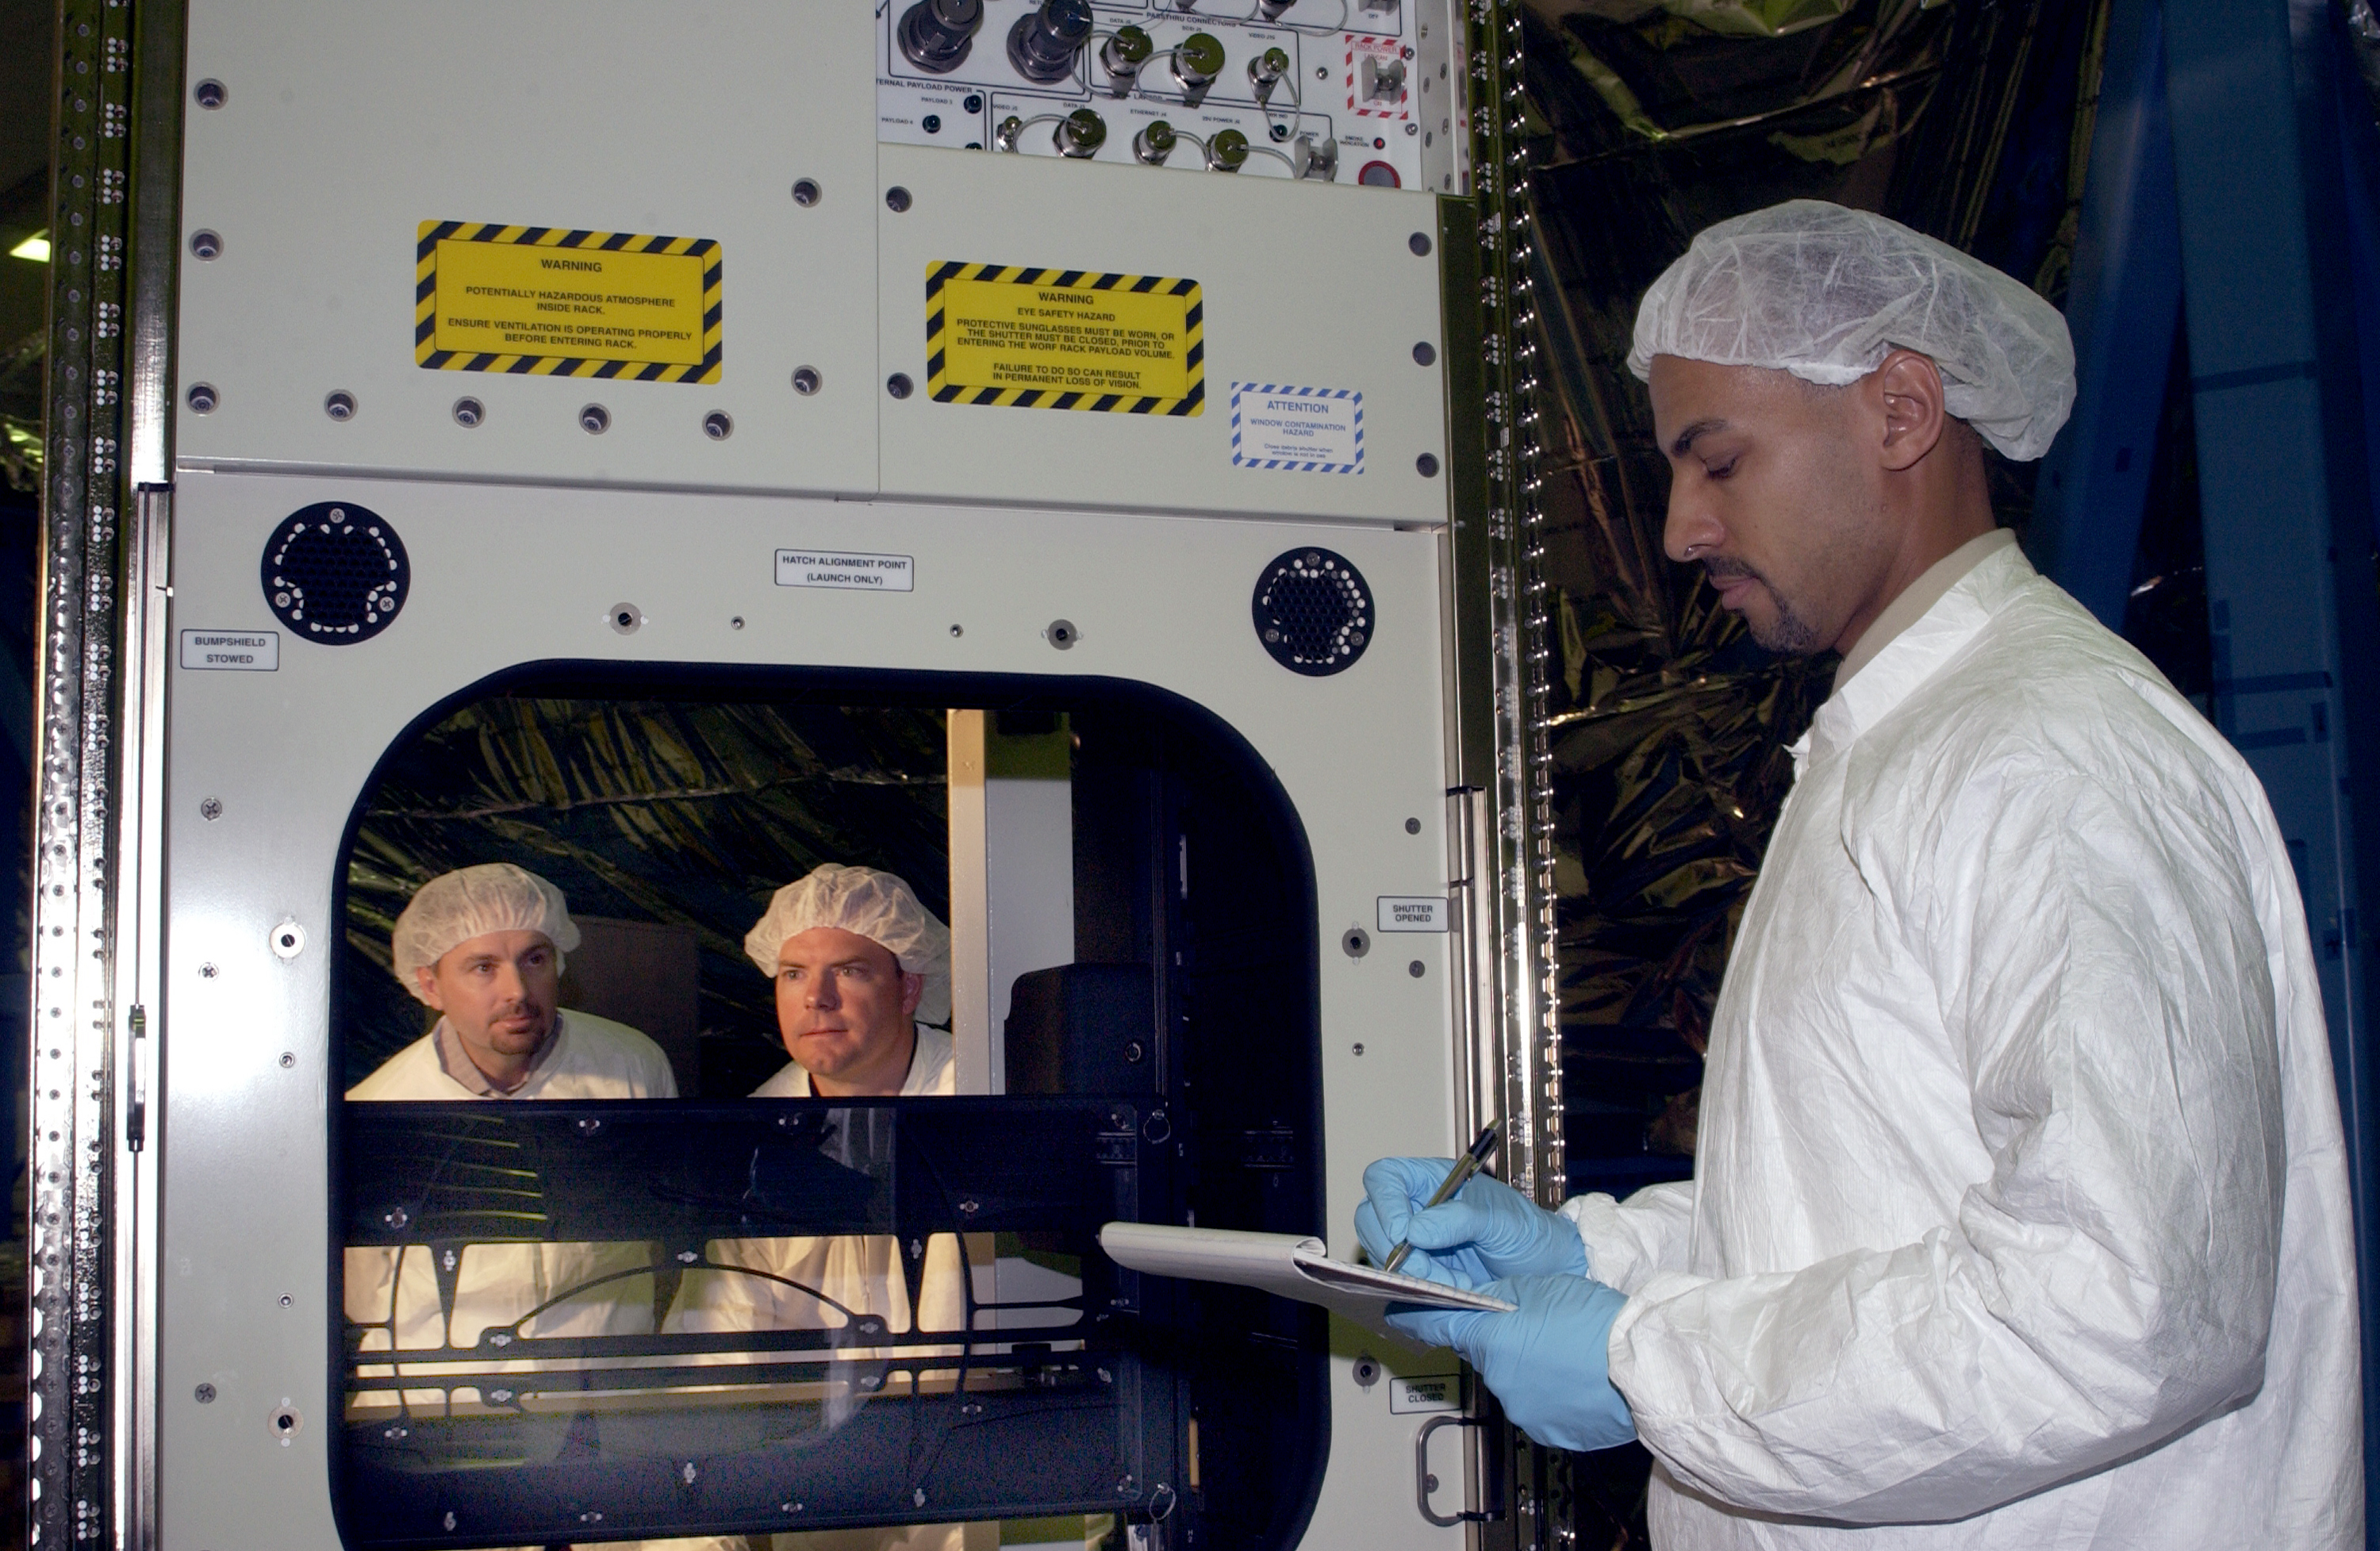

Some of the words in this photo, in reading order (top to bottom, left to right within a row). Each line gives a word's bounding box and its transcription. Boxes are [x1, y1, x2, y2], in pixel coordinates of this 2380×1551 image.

[907, 82, 942, 90] PAYLOAD
[541, 259, 602, 273] WARNING
[466, 286, 536, 299] POTENTIALLY
[539, 291, 604, 302] HAZARDOUS
[605, 296, 675, 307] ATMOSPHERE
[1038, 292, 1094, 305] WARNING
[536, 302, 570, 313] INSIDE
[574, 305, 605, 315] RACK.
[1017, 308, 1035, 317] EYE
[1038, 309, 1075, 319] SAFETY
[1077, 311, 1115, 322] HAZARD
[448, 318, 491, 328] ENSURE
[494, 321, 561, 333] VENTILATION
[563, 324, 574, 334] IS
[577, 325, 635, 337] OPERATING
[639, 330, 693, 340] PROPERLY
[957, 318, 1016, 330] PROTECTIVE
[1019, 321, 1082, 333] SUNGLASSES
[1084, 325, 1111, 336] MUST
[1113, 328, 1125, 337] BE
[1161, 332, 1174, 340] OR
[505, 334, 547, 344] BEFORE
[550, 336, 602, 347] ENTERING
[605, 339, 637, 349] RACK.
[968, 328, 986, 337] THE
[988, 329, 1033, 340] SHUTTER
[1035, 332, 1061, 342] MUST
[1063, 334, 1077, 344] BE
[1121, 337, 1151, 348] PRIOR
[1153, 340, 1165, 349] TO
[958, 337, 1006, 349] ENTERING
[1008, 340, 1027, 349] THE
[1029, 342, 1057, 351] WORF
[1059, 344, 1085, 353] RACK
[1088, 345, 1132, 356] PAYLOAD
[1134, 348, 1175, 359] VOLUME.
[993, 363, 1034, 373] FAILURE
[1035, 365, 1049, 374] TO
[1050, 366, 1065, 374] DO
[1067, 367, 1081, 376] SO
[1083, 368, 1103, 378] CAN
[1105, 369, 1141, 380] RESULT
[992, 372, 1003, 381] IN
[1004, 373, 1063, 385] PERMANENT
[1065, 376, 1091, 386] LOSS
[1093, 378, 1106, 387] OF
[1108, 379, 1142, 390] VISION.
[1268, 401, 1329, 413] ATTENTION
[1250, 418, 1283, 427] WINDOW
[1284, 420, 1346, 432] CONTAMINATION
[783, 556, 816, 565] HATCH
[819, 558, 875, 568] ALIGNMENT
[878, 561, 907, 570] POINT
[807, 573, 850, 583] (LAUNCH
[854, 575, 883, 585] ONLY)
[195, 636, 266, 647] BUMPSHIELD
[206, 655, 254, 663] STOWED
[1406, 1384, 1445, 1393] SHUTTER
[1408, 1393, 1444, 1403] CLOSED
